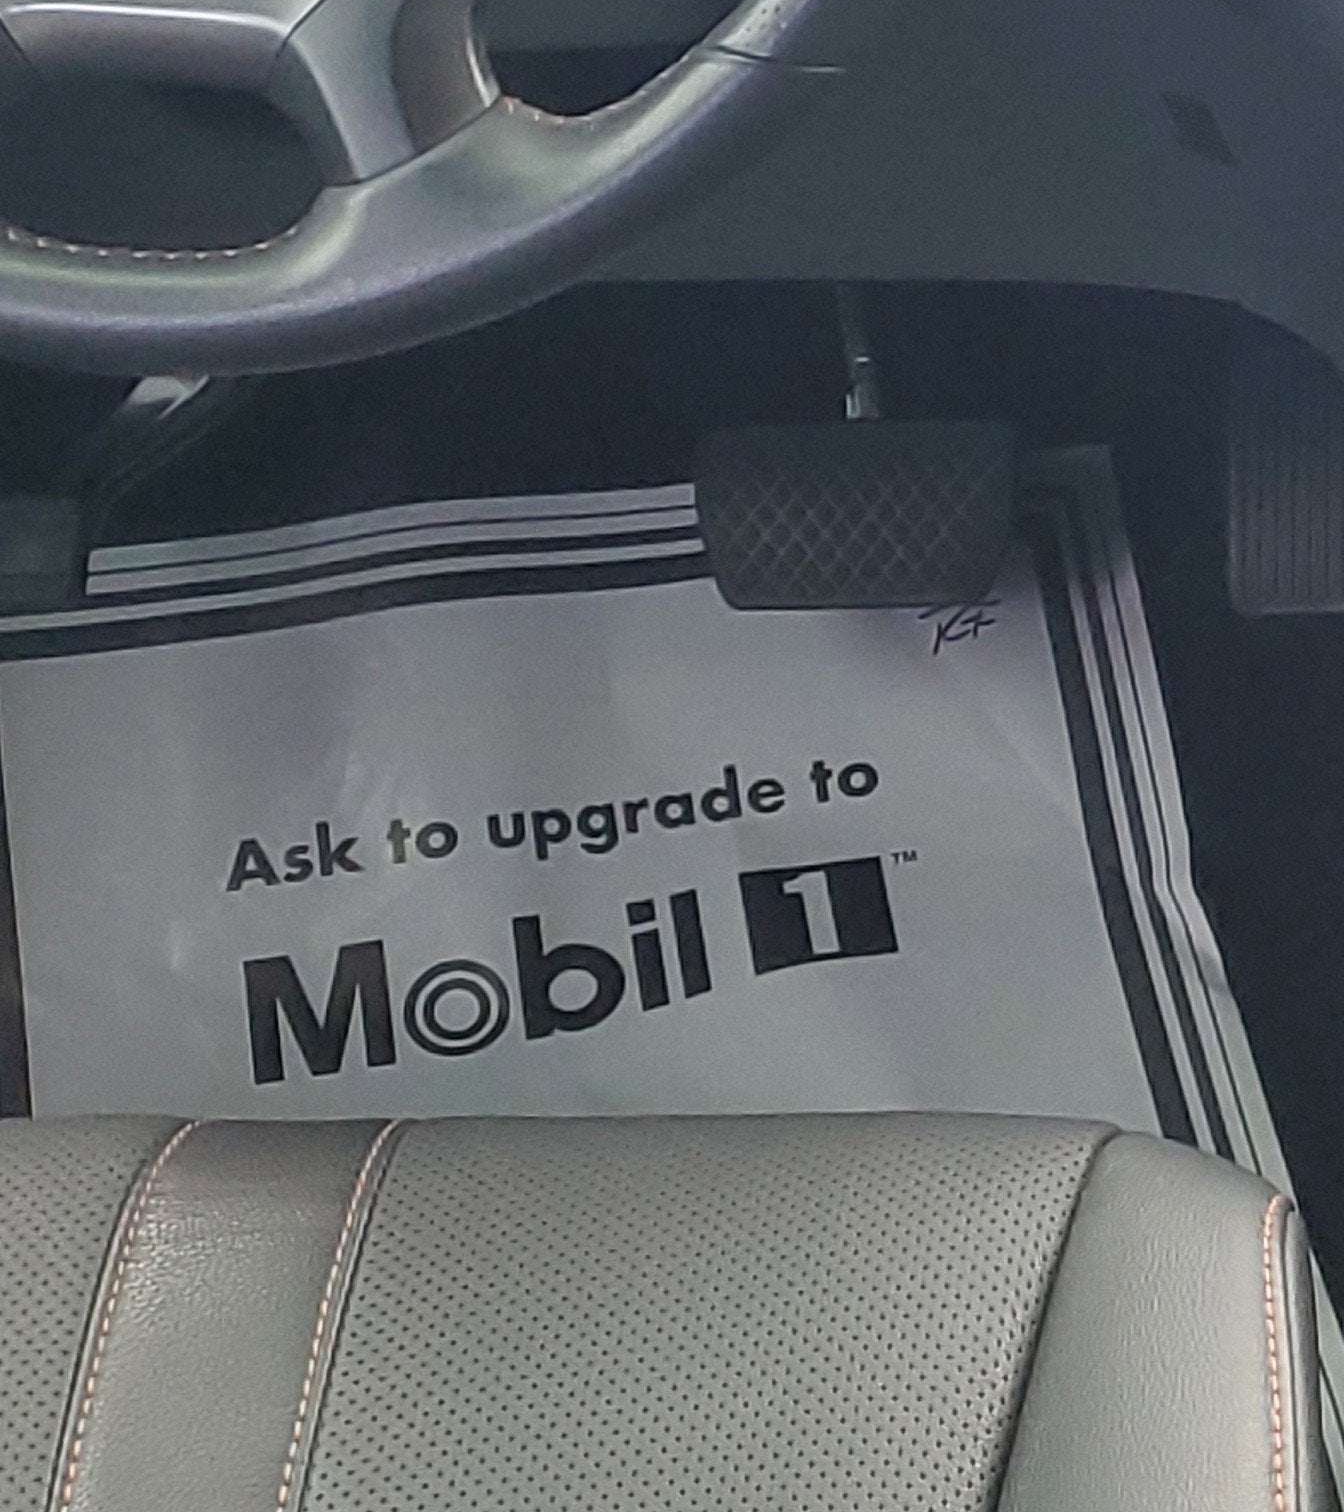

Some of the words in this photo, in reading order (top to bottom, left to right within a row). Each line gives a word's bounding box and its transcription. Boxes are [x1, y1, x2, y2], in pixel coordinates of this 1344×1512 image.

[226, 821, 365, 892] Ask
[386, 818, 459, 864] to
[487, 764, 786, 861] upgrade
[810, 760, 879, 804] to
[243, 889, 712, 1086] Mobil
